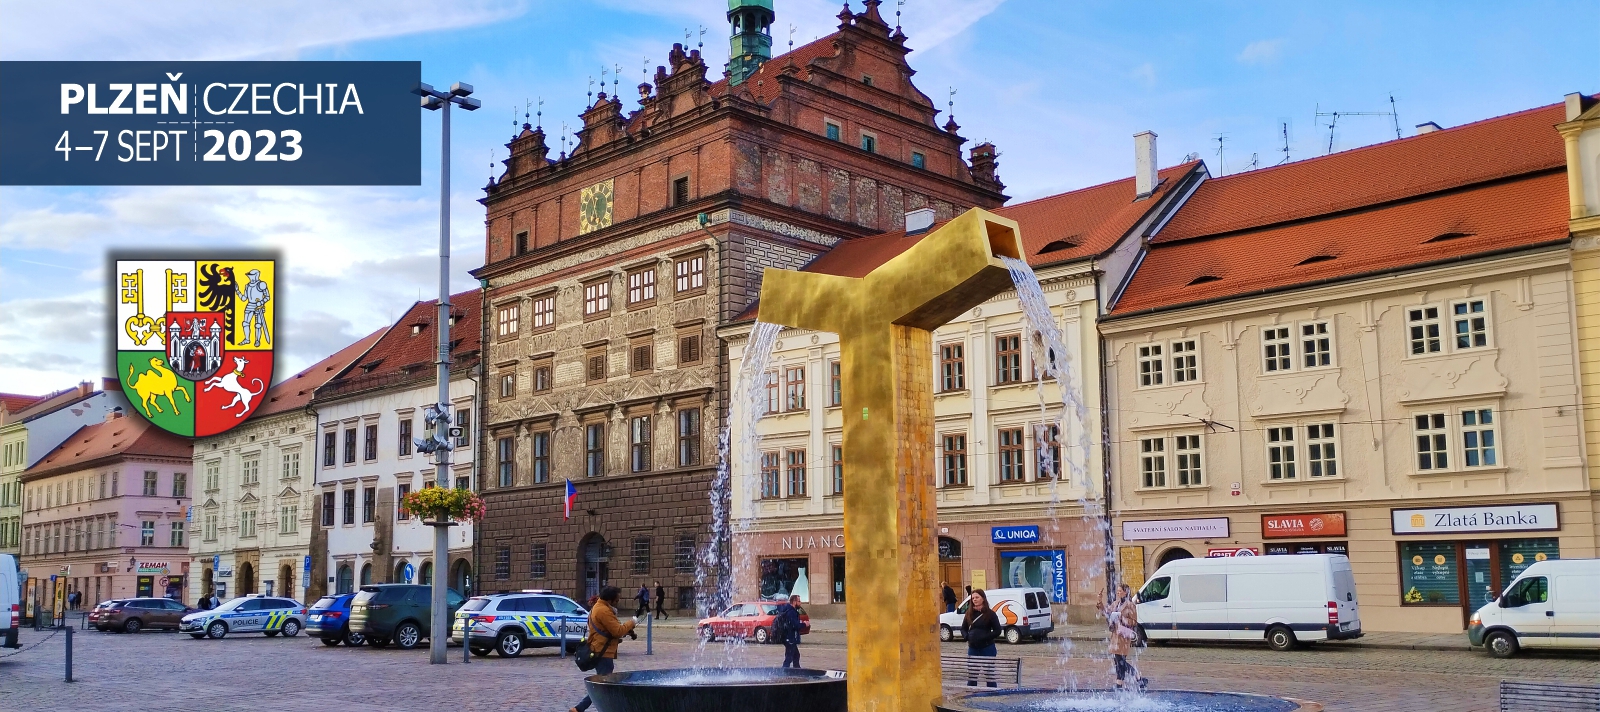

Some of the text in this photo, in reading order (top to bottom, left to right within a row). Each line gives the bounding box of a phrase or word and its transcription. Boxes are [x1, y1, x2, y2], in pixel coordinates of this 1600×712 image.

[1434, 510, 1538, 527] Zlatá Banka
[1267, 519, 1304, 529] SLAVIA
[1007, 529, 1036, 539] UNIQA
[1055, 553, 1064, 585] UNIQA
[232, 618, 259, 626] POLICIE
